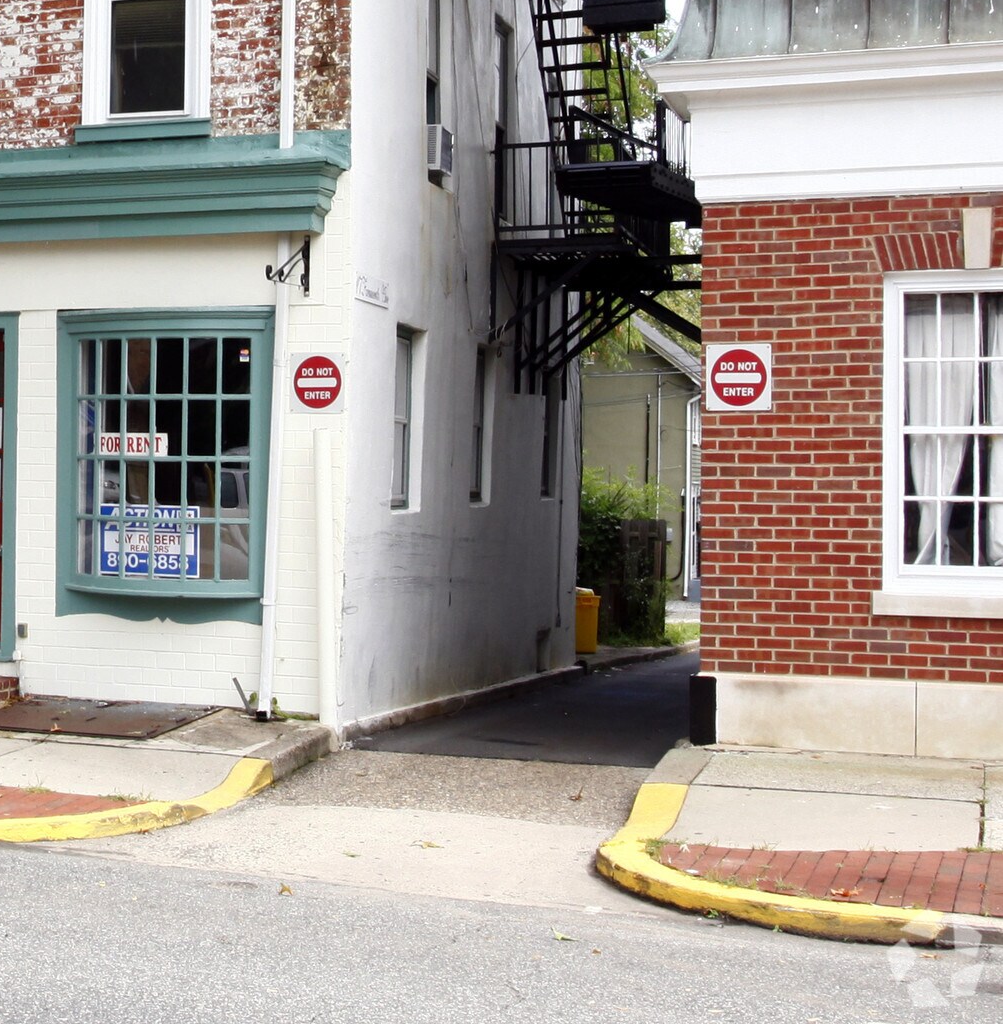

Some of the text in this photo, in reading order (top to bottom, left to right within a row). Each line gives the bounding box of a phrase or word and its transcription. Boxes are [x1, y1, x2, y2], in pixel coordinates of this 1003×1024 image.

[720, 362, 757, 371] DO NOT
[301, 368, 333, 376] DO NOT
[304, 391, 331, 399] ENTER
[723, 387, 754, 396] ENTER
[100, 436, 162, 453] FOR RENT
[130, 545, 169, 554] REALORS
